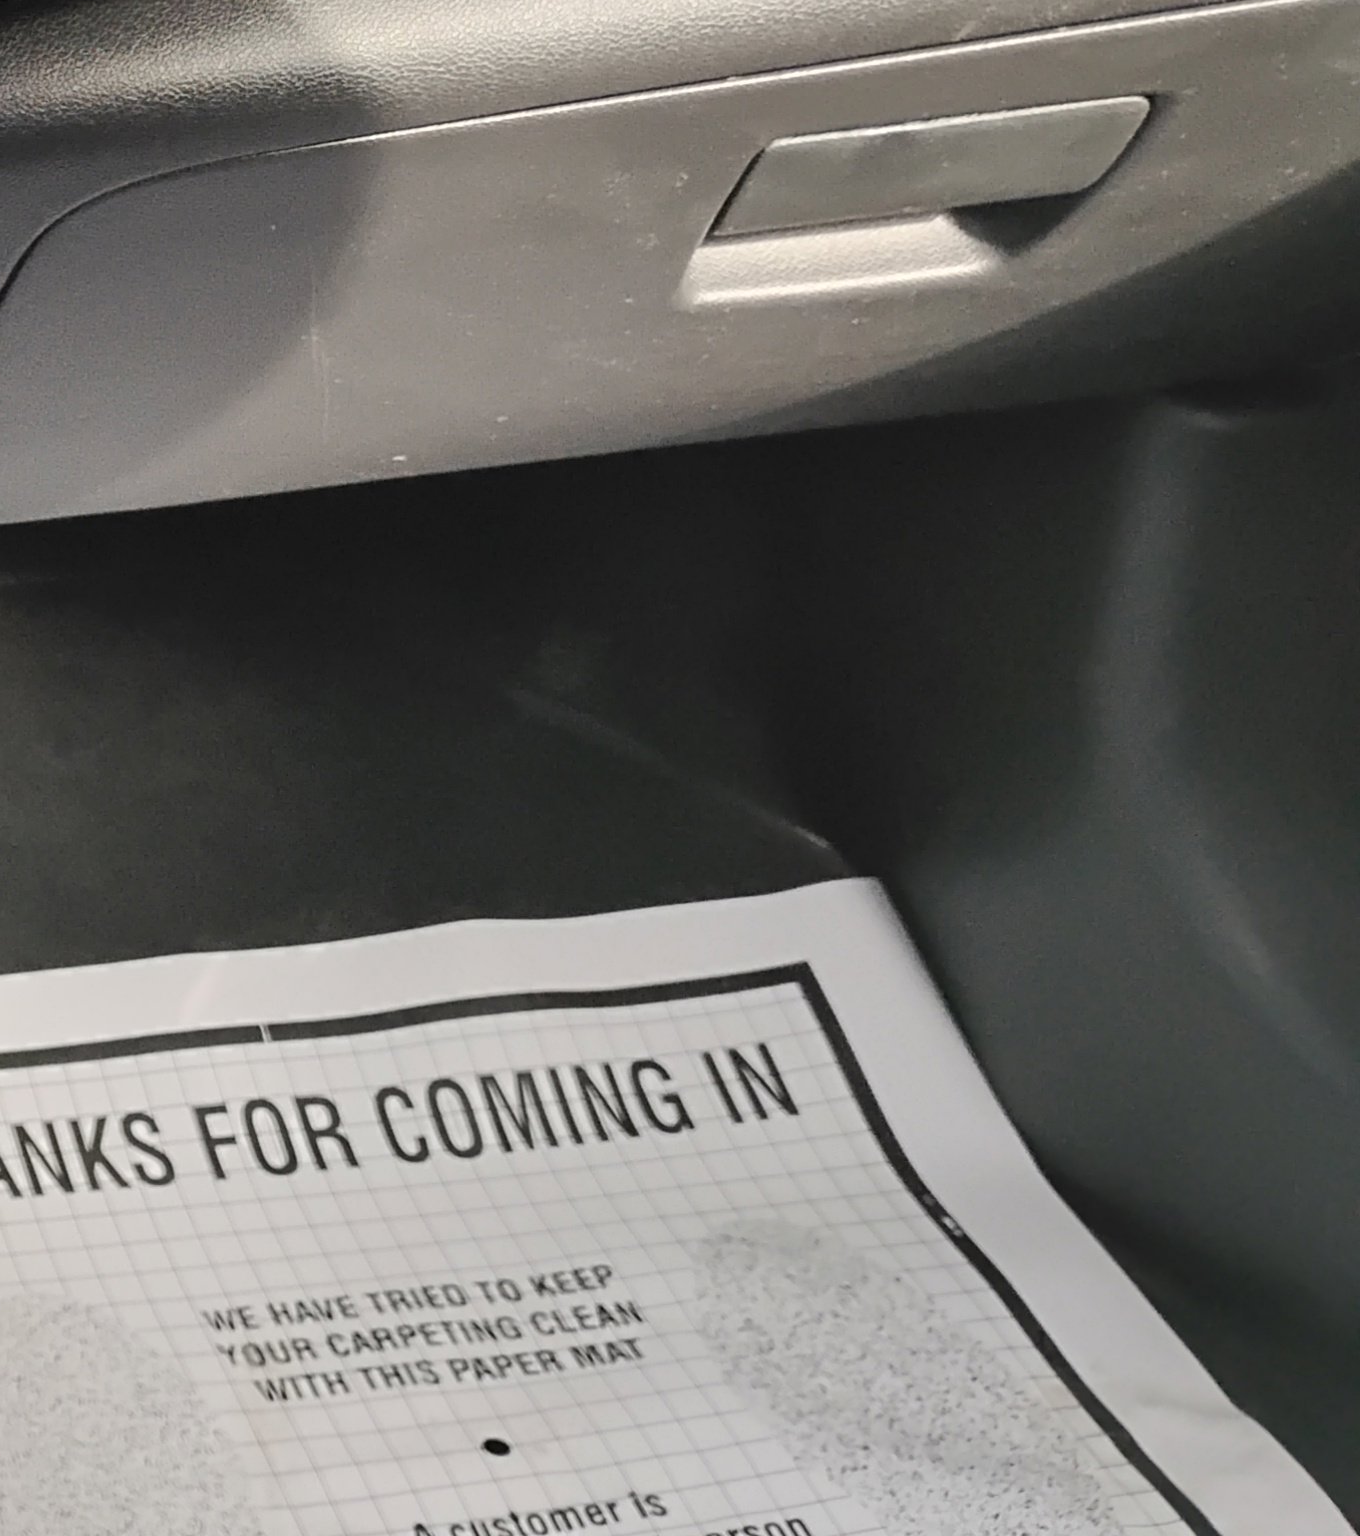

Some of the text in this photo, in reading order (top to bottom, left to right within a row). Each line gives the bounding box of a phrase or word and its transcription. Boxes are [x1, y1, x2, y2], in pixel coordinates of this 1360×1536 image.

[193, 1095, 361, 1181] FOR
[374, 1058, 696, 1165] COMING
[703, 1041, 800, 1125] IN
[200, 1263, 616, 1334] WE HAVE TRIED TO KEEP
[216, 1300, 646, 1368] YOUR CARPETING CLEAN
[253, 1336, 647, 1404] WITH THIS PAPER MAT
[628, 1490, 669, 1519] is
